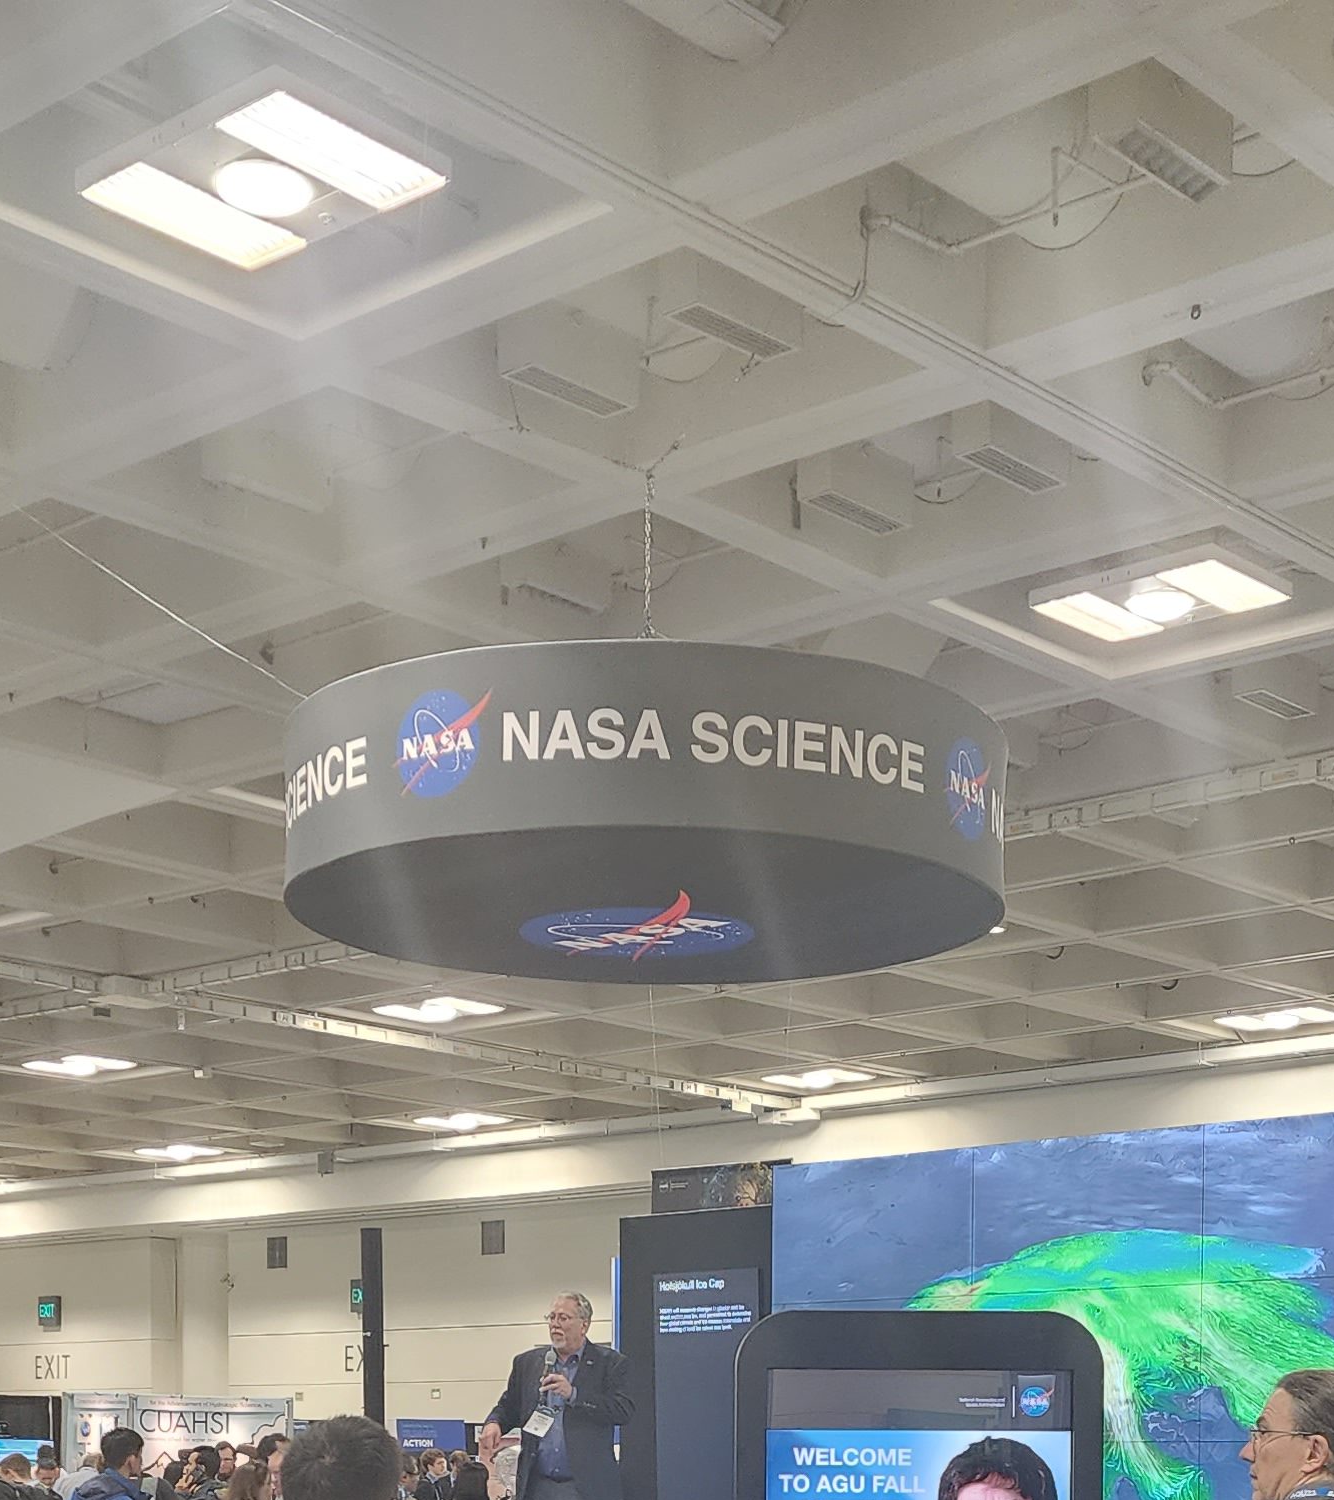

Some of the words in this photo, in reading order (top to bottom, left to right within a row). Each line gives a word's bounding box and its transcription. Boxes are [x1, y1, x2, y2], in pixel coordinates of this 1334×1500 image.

[402, 727, 474, 760] NASA
[501, 708, 671, 762] NASA
[690, 711, 926, 793] SCIENCE
[286, 736, 367, 838] CIENCE
[950, 768, 985, 810] NASA
[553, 918, 731, 951] NASA
[352, 1288, 363, 1304] EX
[39, 1304, 55, 1318] EXIT
[35, 1354, 71, 1380] EXIT
[140, 1409, 229, 1434] CUAHSI
[403, 1439, 434, 1448] ACTION
[793, 1447, 912, 1466] WELCOME
[778, 1474, 810, 1493] TO
[816, 1474, 865, 1493] AGU
[872, 1475, 926, 1493] FALL
